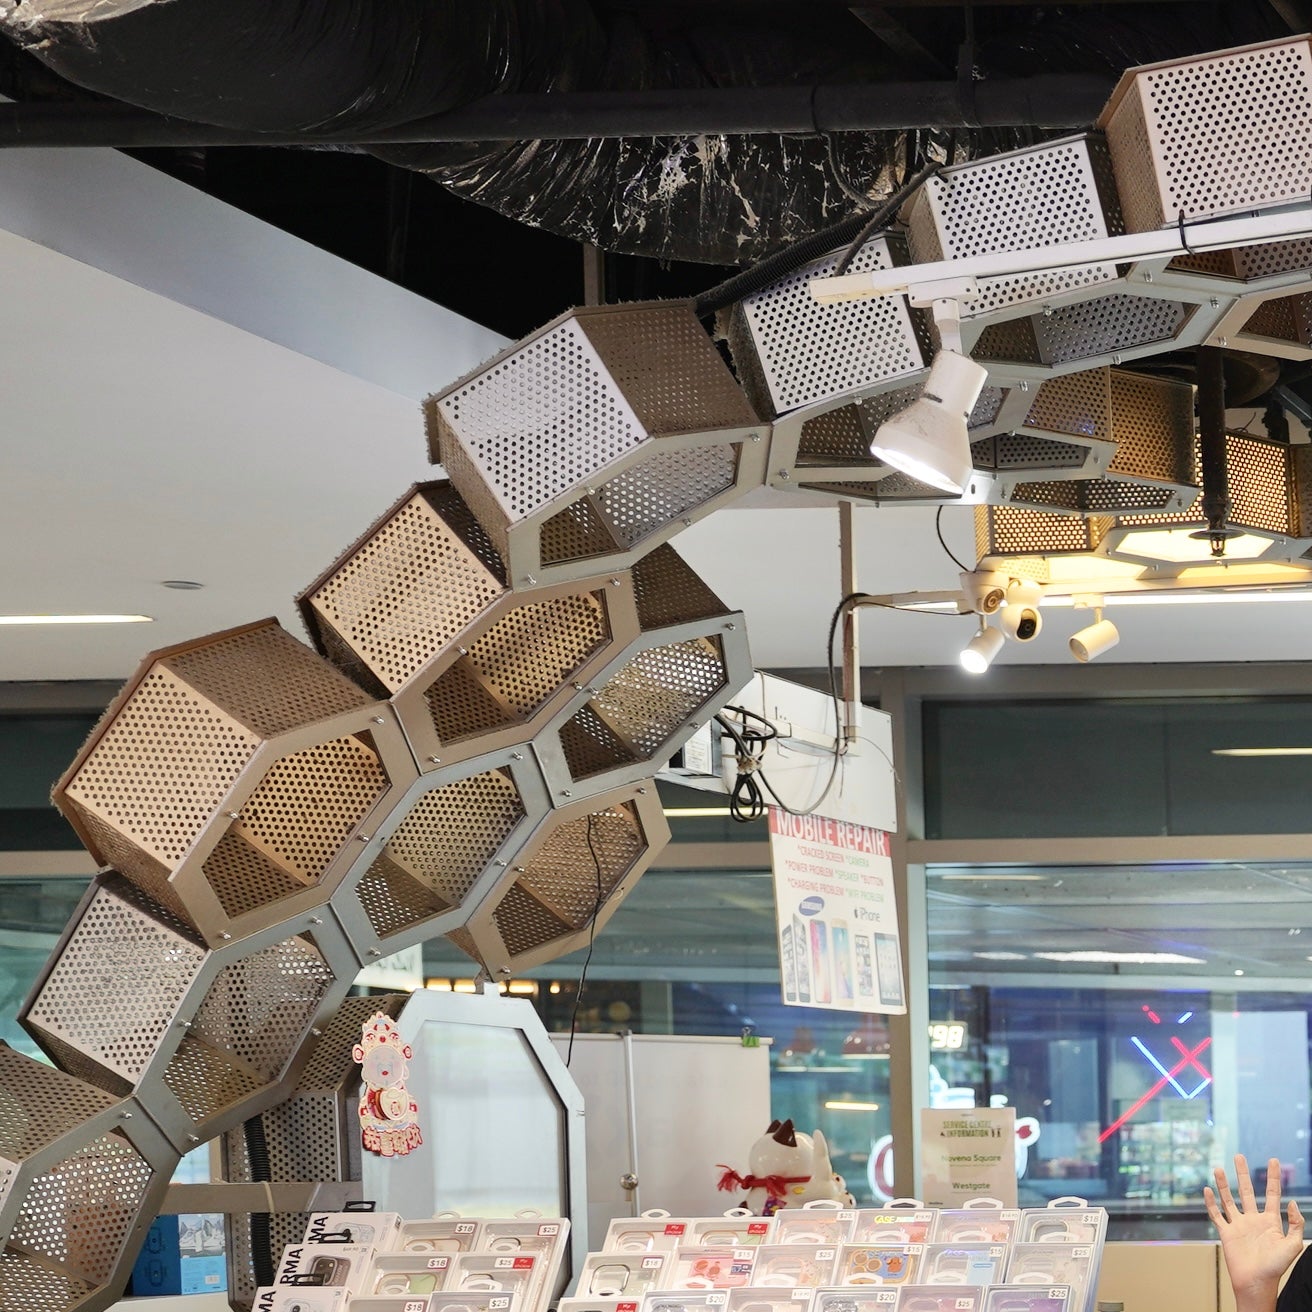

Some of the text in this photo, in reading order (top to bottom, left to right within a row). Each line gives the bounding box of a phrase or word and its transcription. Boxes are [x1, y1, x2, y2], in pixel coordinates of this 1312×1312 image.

[776, 810, 836, 847] MOBILE
[837, 823, 886, 857] REPAIR
[877, 1292, 895, 1302] $20
[1051, 1288, 1067, 1299] $25
[404, 1301, 424, 1312] $18
